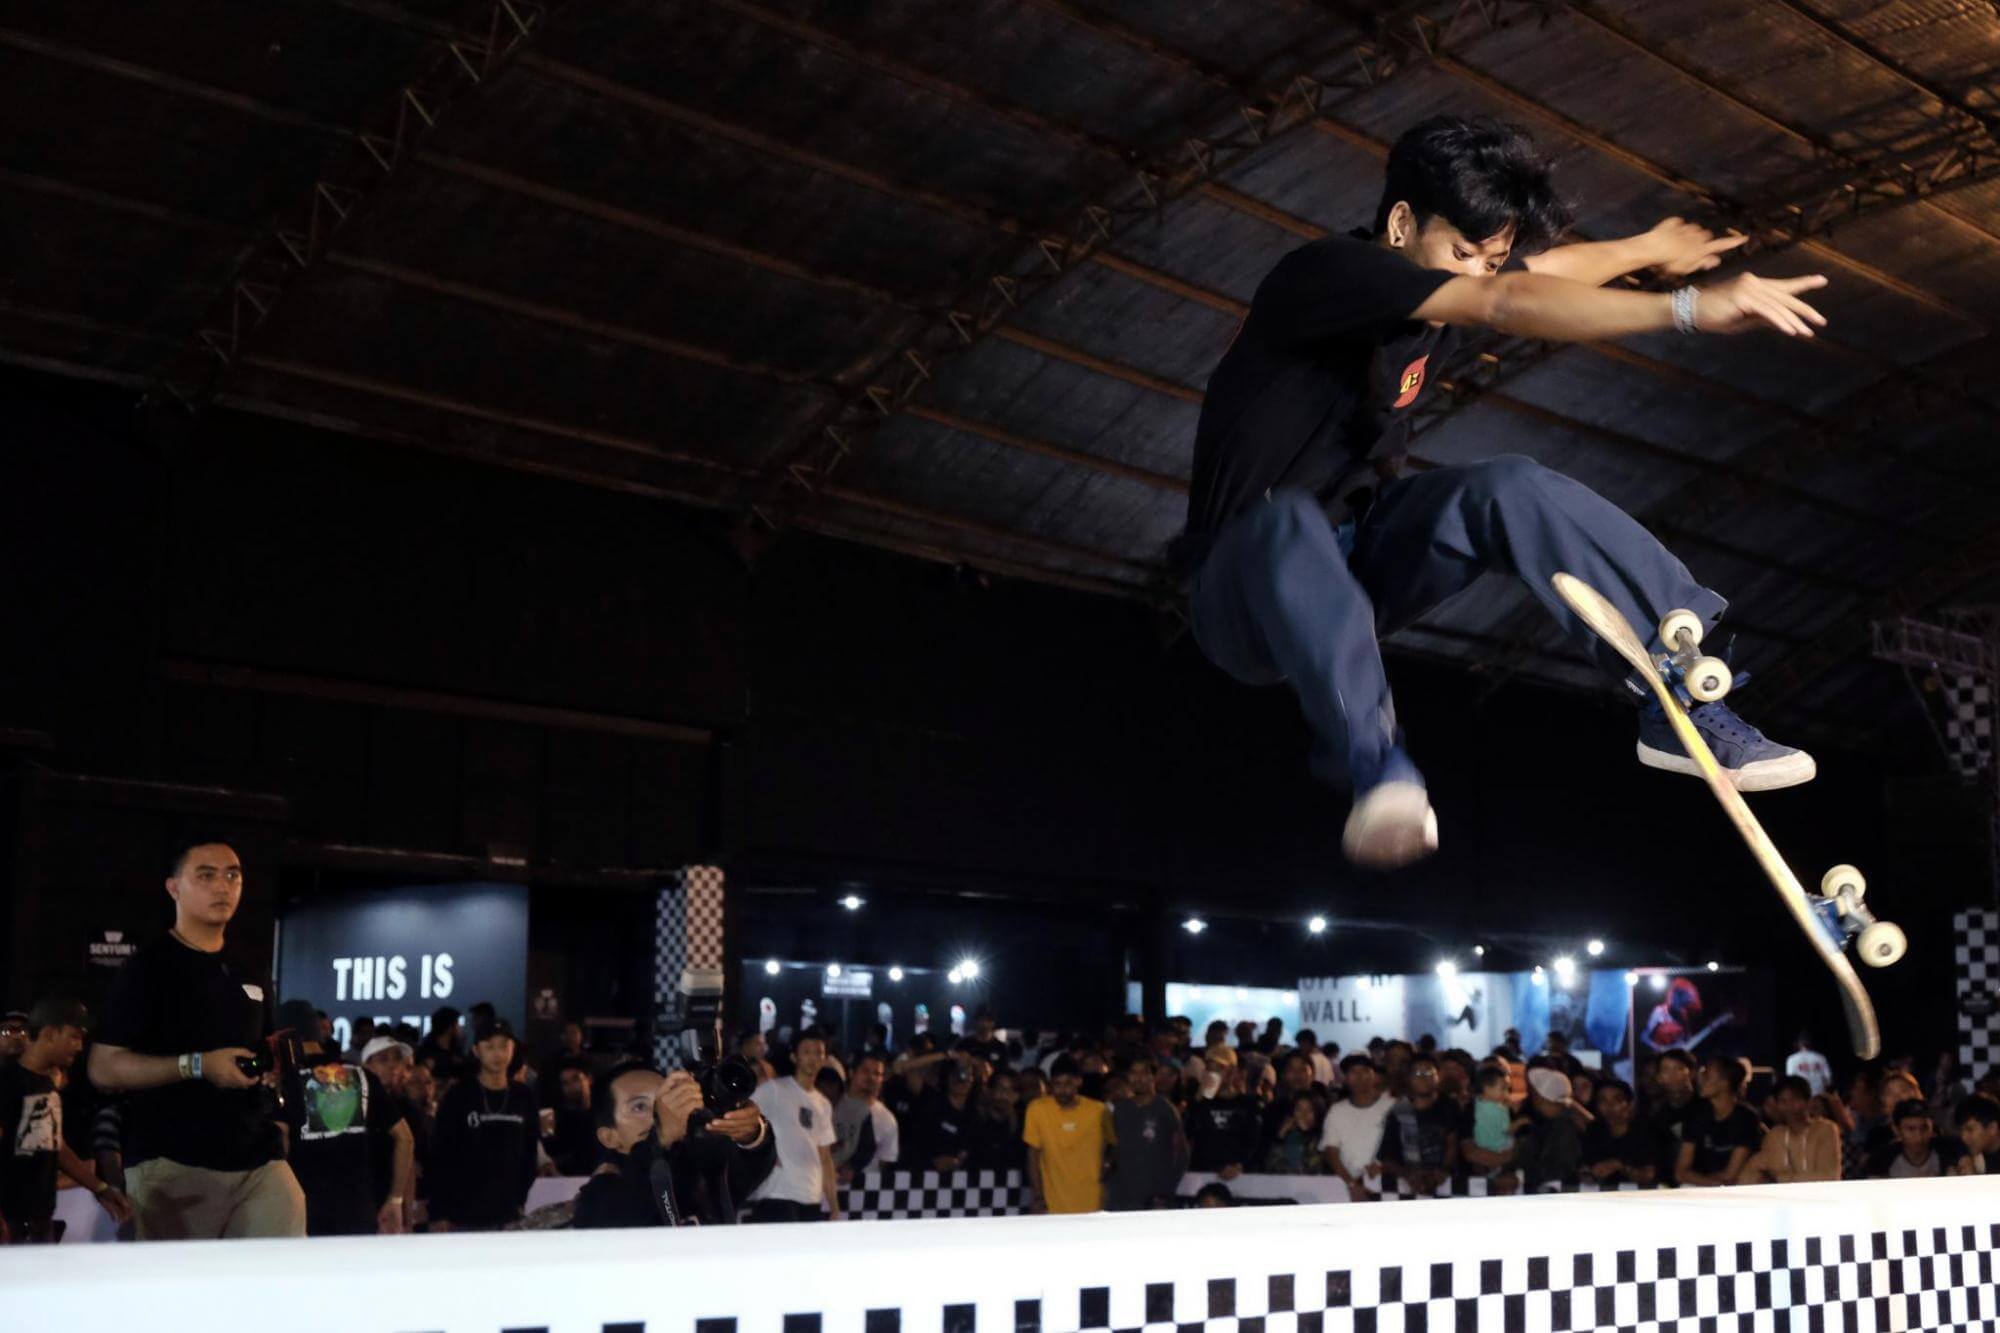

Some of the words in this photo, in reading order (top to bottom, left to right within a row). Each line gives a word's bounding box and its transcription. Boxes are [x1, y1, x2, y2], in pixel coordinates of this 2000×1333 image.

[332, 955, 408, 1001] THIS
[420, 952, 455, 999] IS
[1301, 999, 1371, 1023] WALL.
